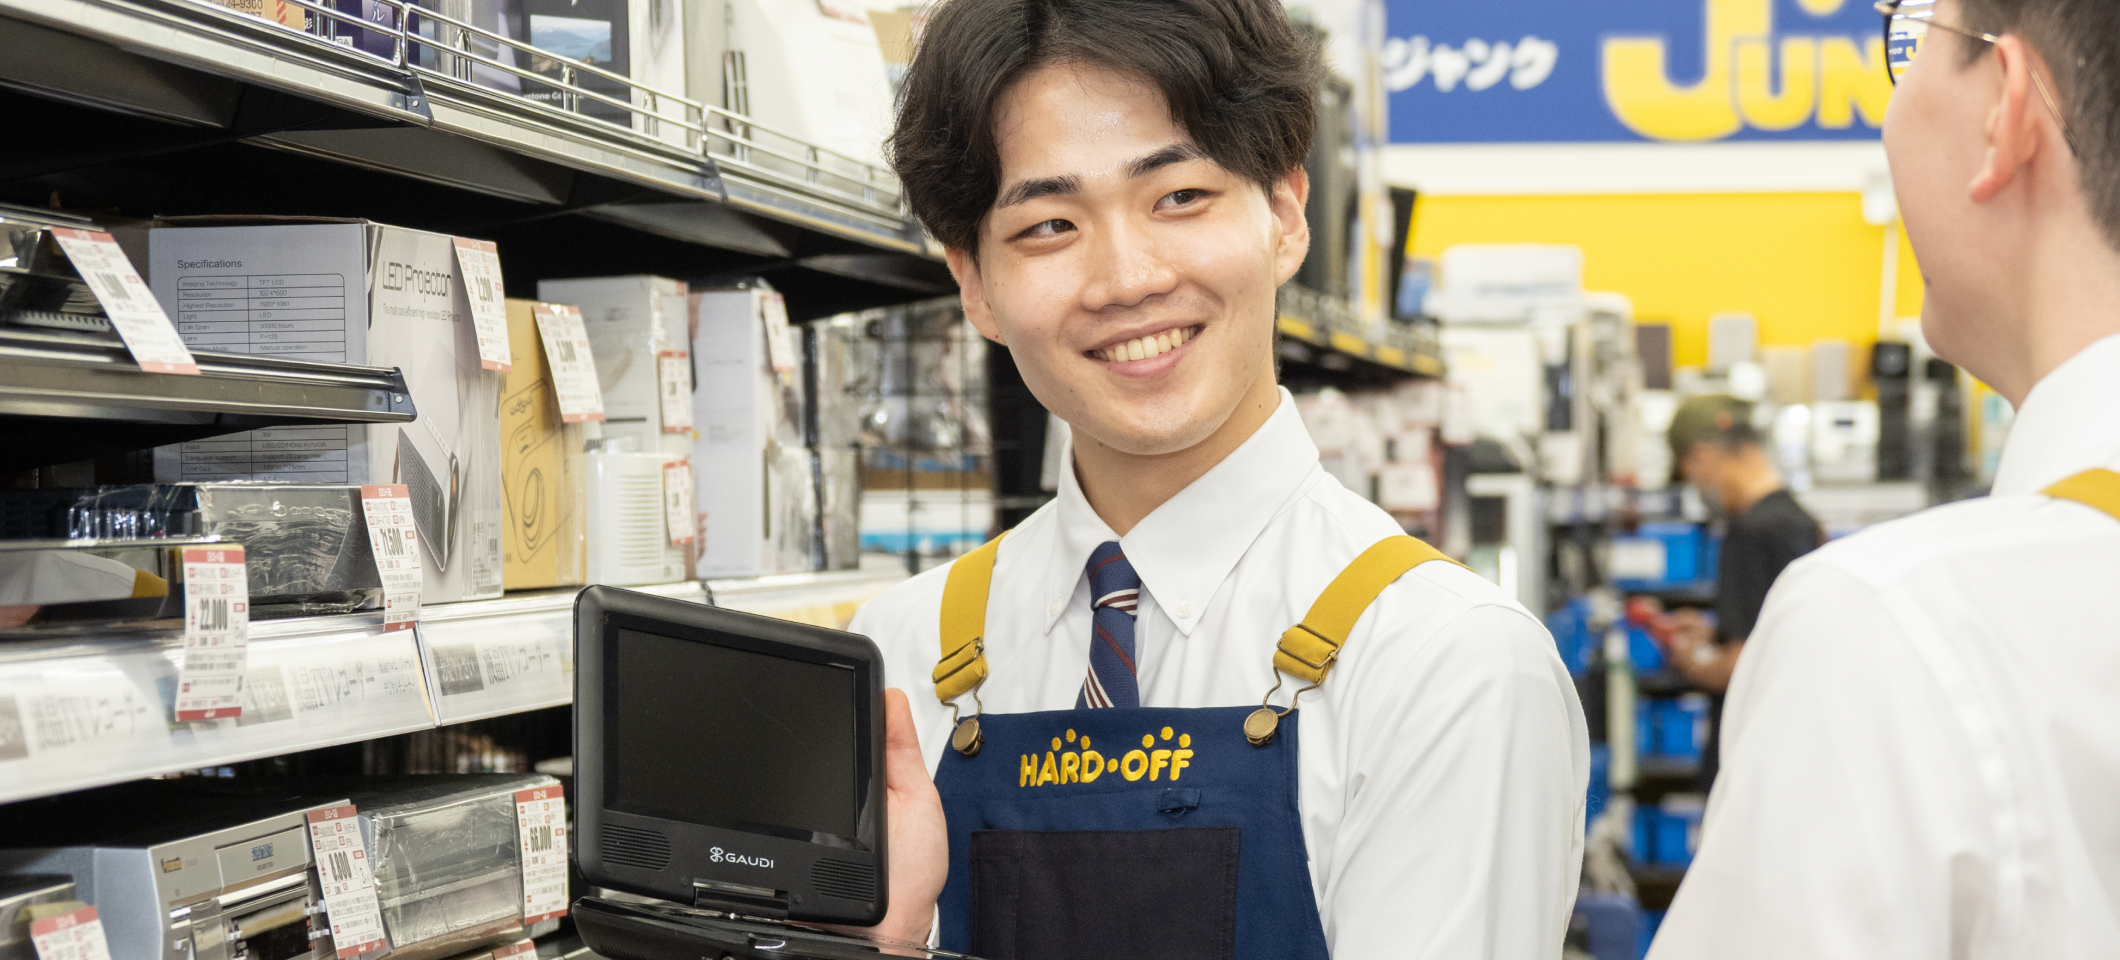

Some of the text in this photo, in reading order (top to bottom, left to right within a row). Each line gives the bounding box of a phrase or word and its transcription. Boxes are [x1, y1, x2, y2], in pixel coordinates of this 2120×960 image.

[1381, 34, 1559, 93] ジャンク
[177, 259, 242, 270] Specifications
[383, 261, 403, 291] LED
[405, 262, 452, 303] Projector
[281, 344, 308, 352] operation
[380, 527, 404, 558] 71,500
[200, 598, 229, 633] 22,000
[530, 825, 552, 855] 66,000
[725, 853, 774, 869] GAUDI
